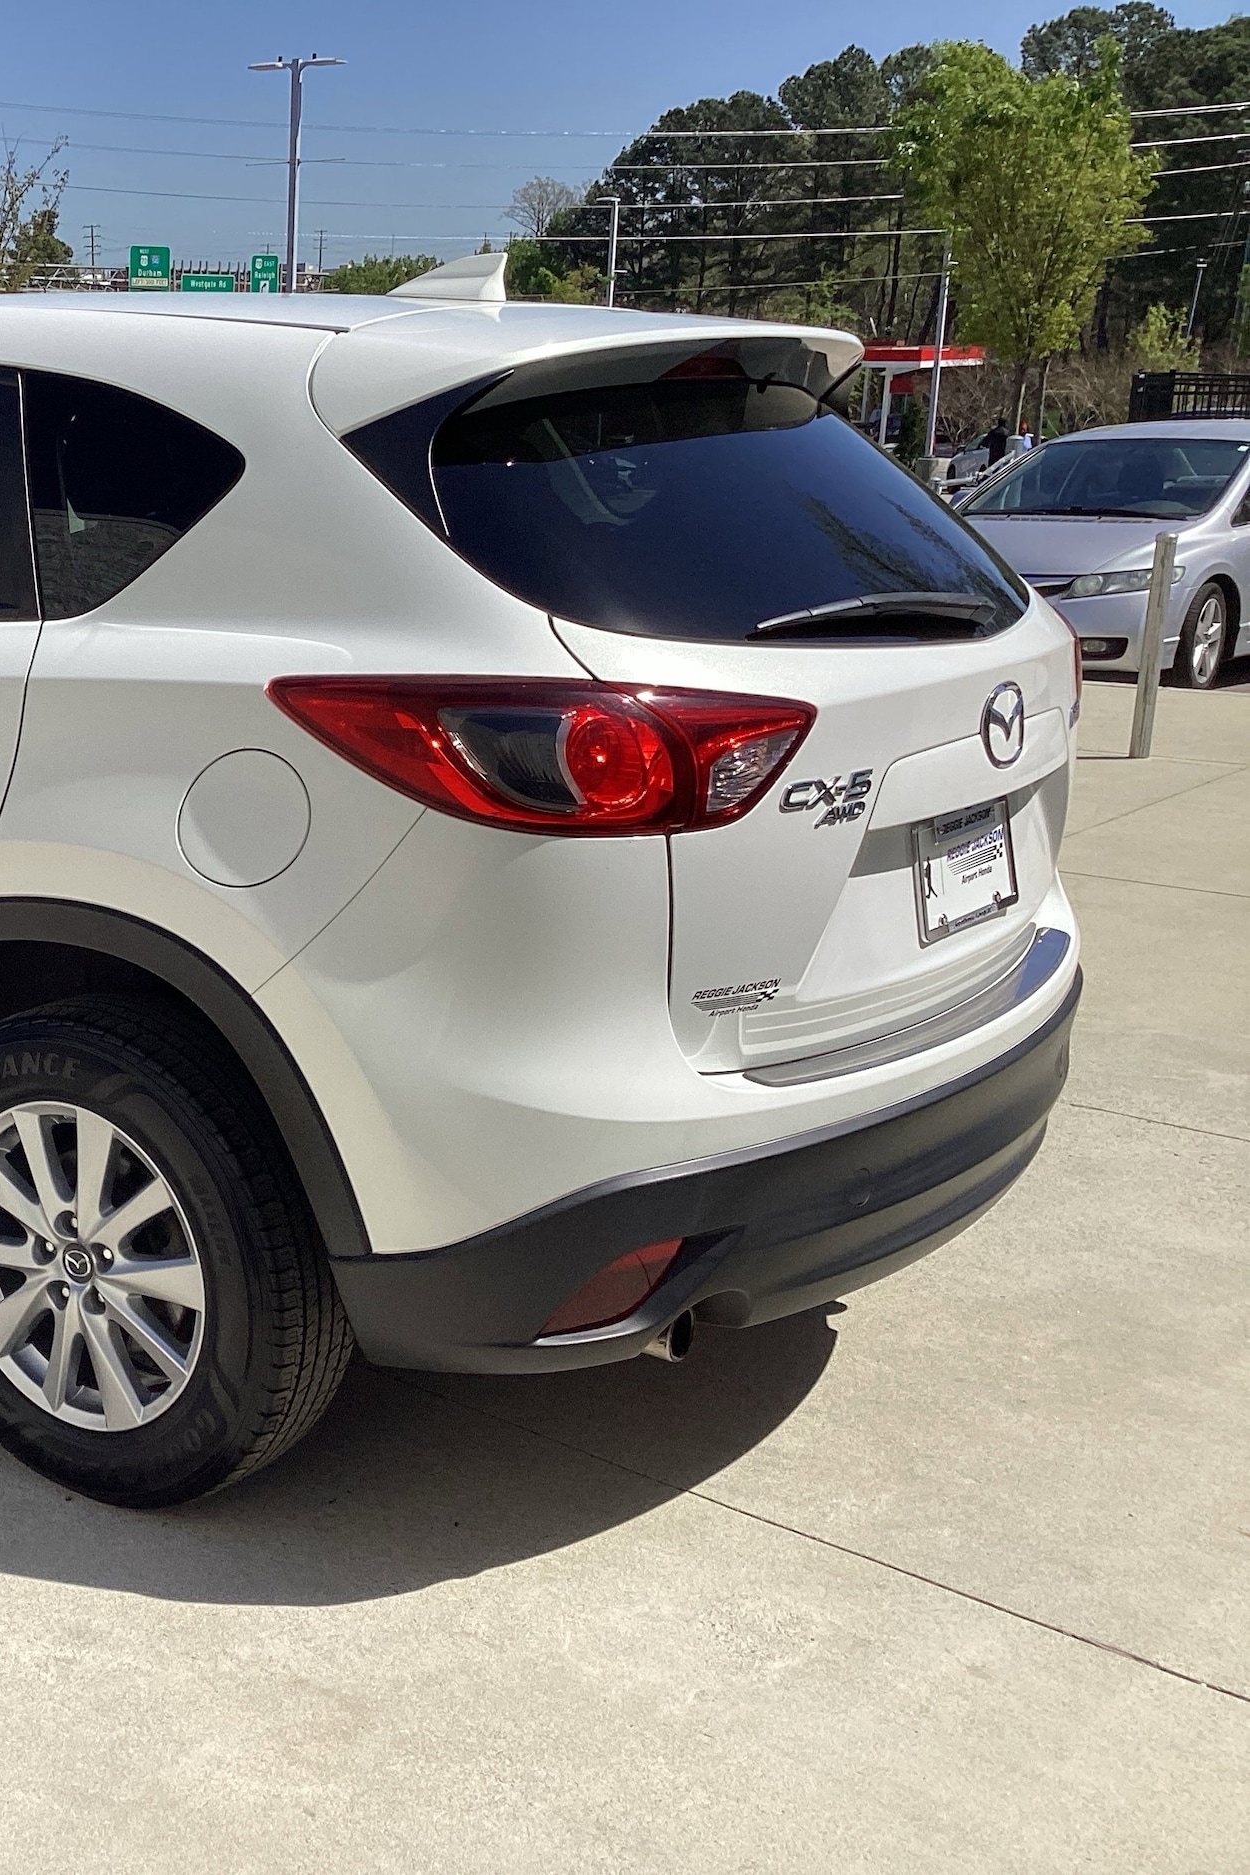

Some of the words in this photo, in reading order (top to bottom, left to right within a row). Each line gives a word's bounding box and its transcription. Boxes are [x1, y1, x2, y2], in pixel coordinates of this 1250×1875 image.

[137, 269, 162, 277] Durham
[254, 271, 276, 281] Raleigh
[190, 280, 217, 289] Westgate
[218, 280, 227, 288] Rd
[779, 768, 873, 813] CX-5
[813, 801, 866, 829] AWD
[964, 806, 993, 827] JACKSON
[947, 840, 971, 862] REGGIE
[971, 827, 1004, 852] JACKSON
[961, 871, 978, 885] Airport
[978, 865, 993, 877] Honda
[692, 986, 734, 1001] REGGIE
[732, 978, 782, 995] JACKSON
[708, 1008, 736, 1018] Airport
[736, 1004, 759, 1013] Honda
